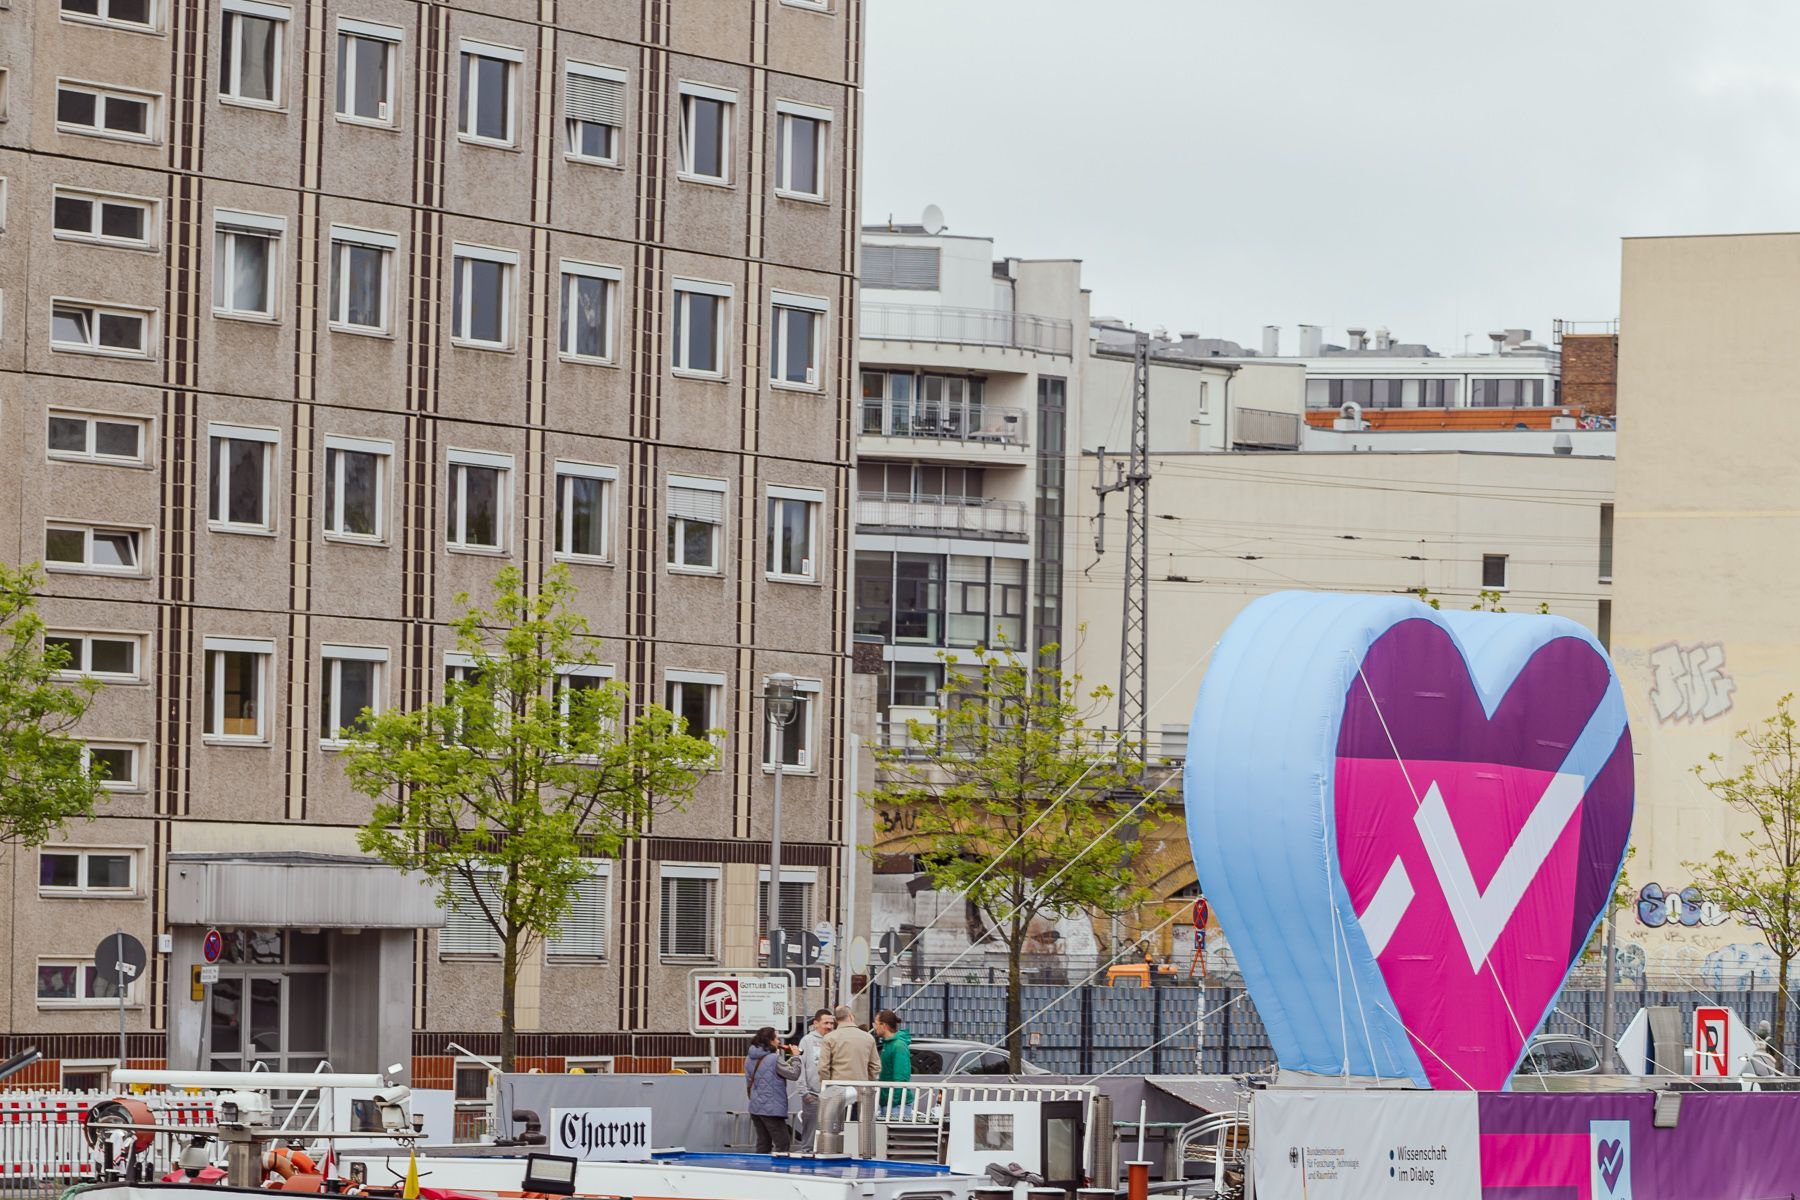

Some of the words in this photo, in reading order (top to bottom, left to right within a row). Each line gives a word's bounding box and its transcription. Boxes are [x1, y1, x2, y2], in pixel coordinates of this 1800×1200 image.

[560, 1111, 646, 1159] Charon
[1306, 1146, 1345, 1156] Bundesministerium
[1397, 1145, 1448, 1161] Wissenschaft
[1398, 1168, 1409, 1182] im
[1410, 1166, 1435, 1185] Dialog
